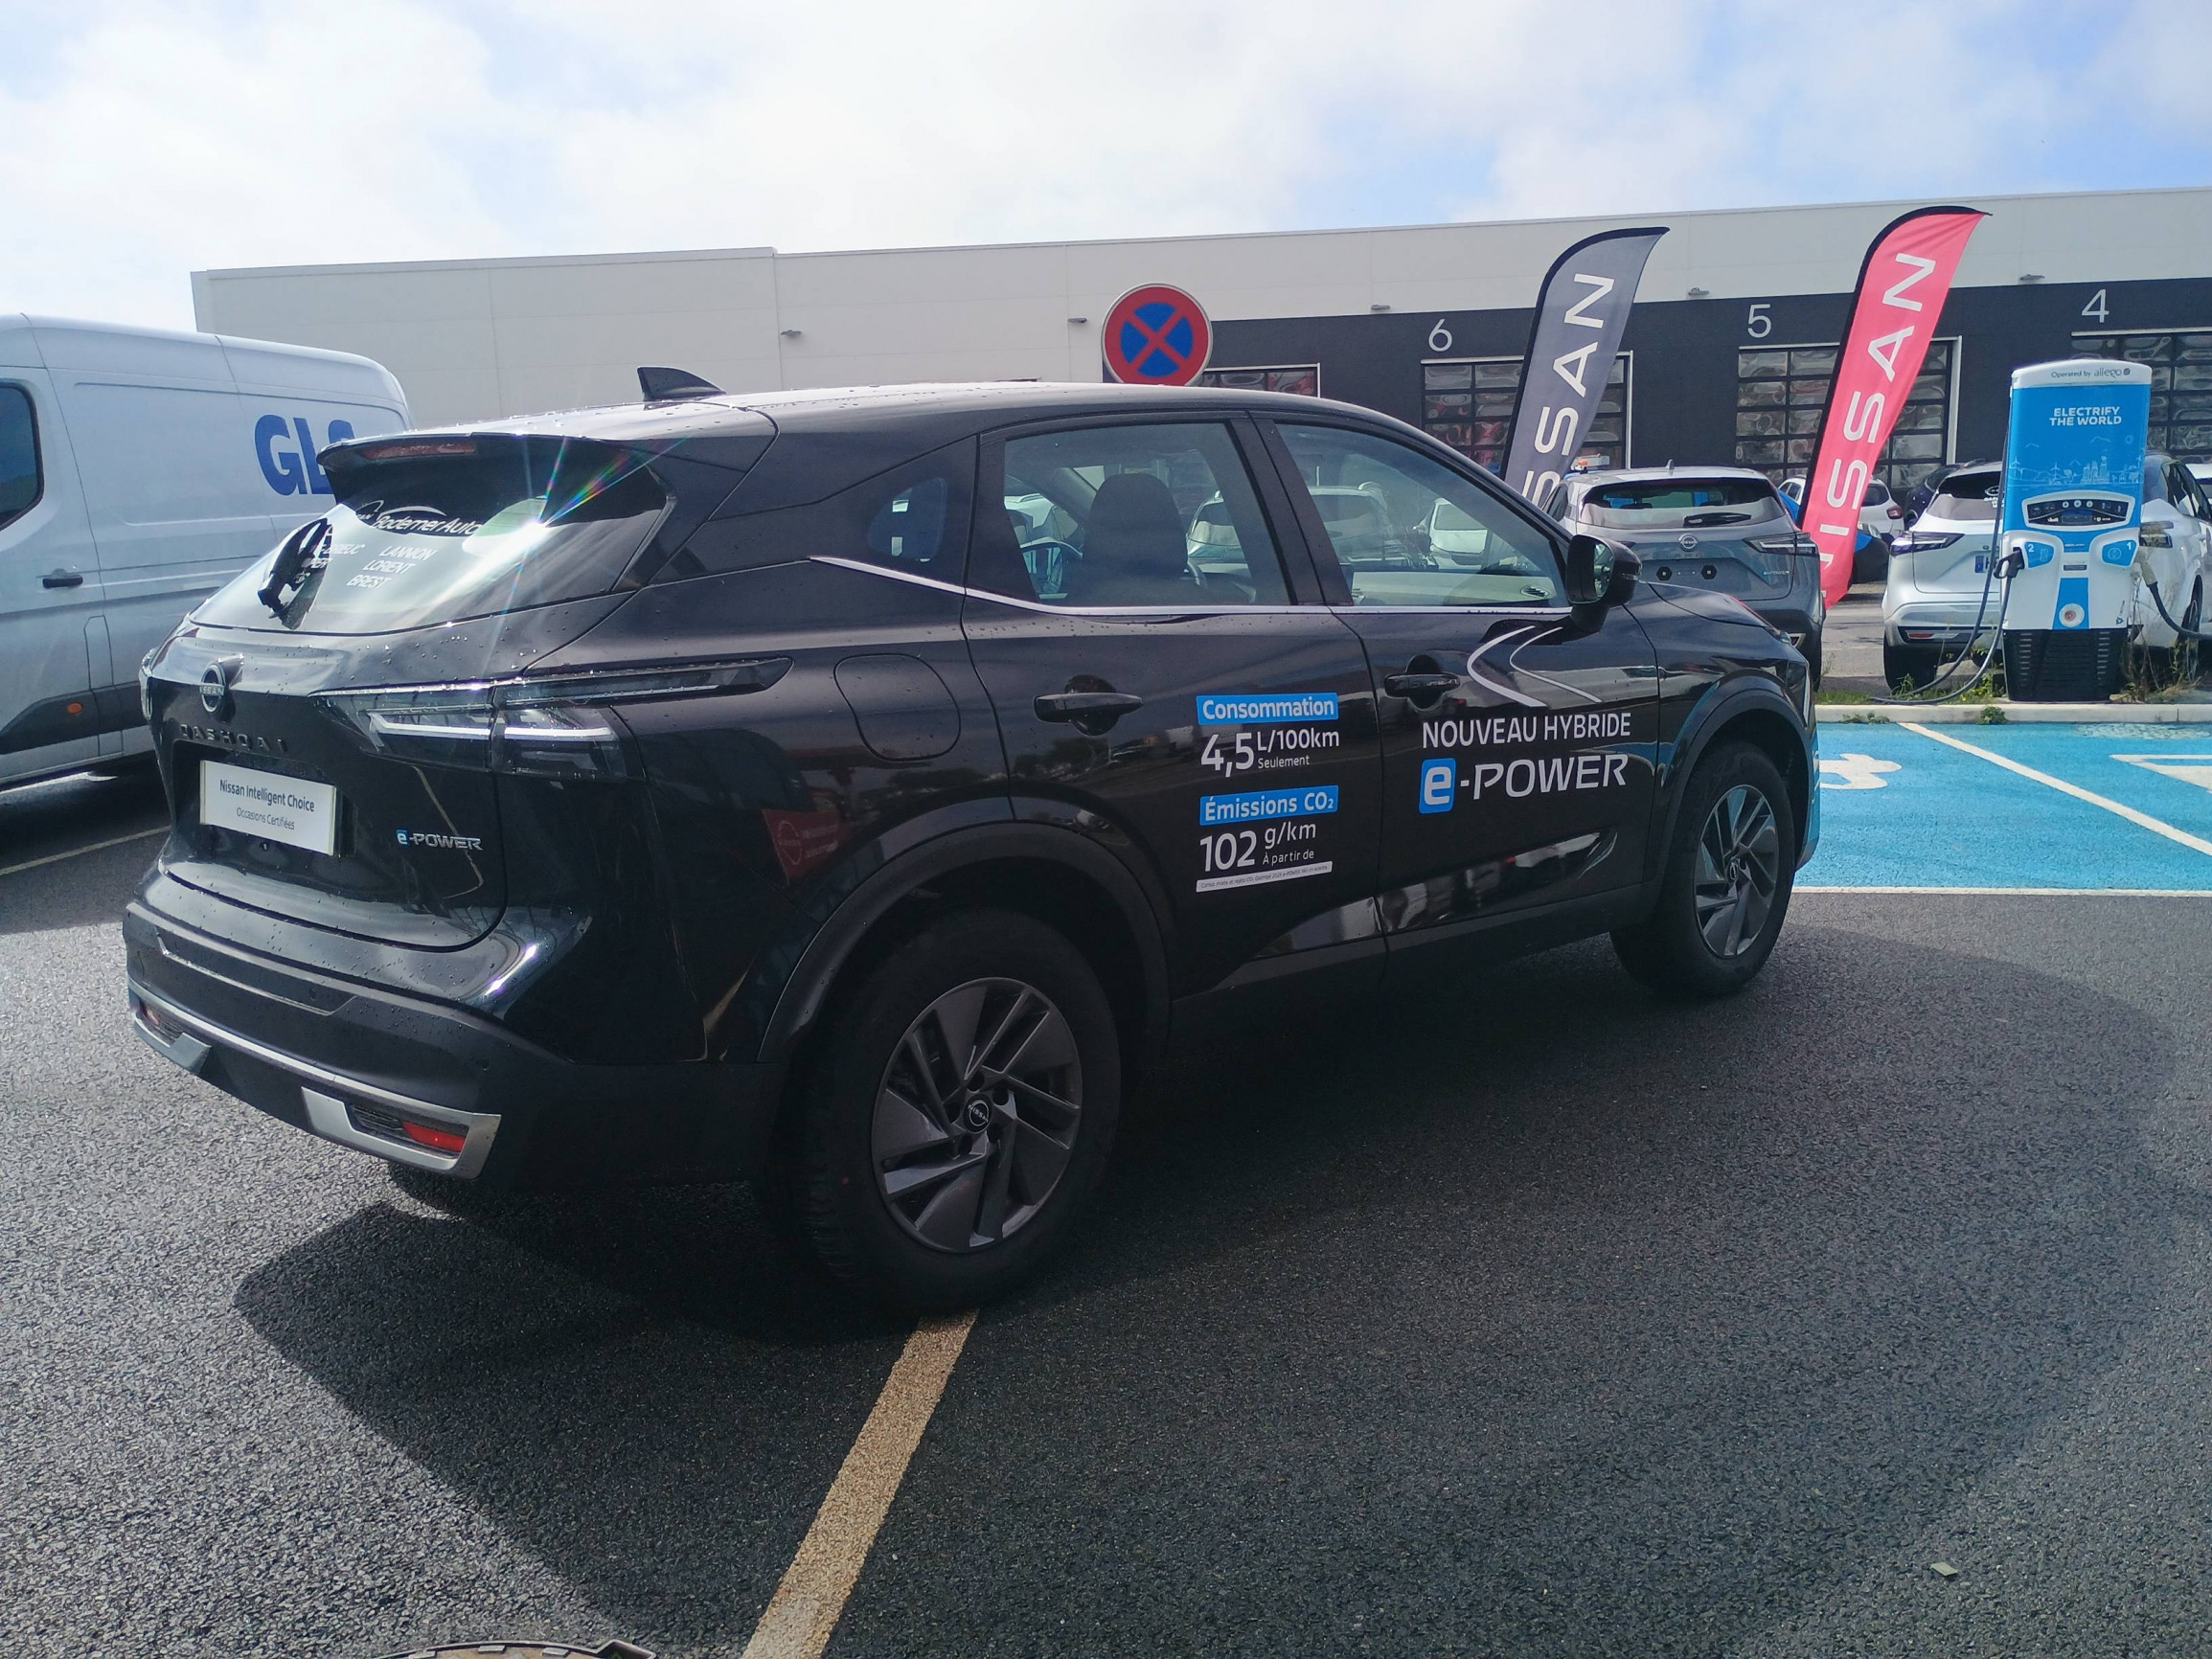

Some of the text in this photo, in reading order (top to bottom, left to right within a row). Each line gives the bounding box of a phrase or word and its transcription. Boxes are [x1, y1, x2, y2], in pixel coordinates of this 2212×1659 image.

[2081, 288, 2109, 324] 4
[1747, 304, 1772, 339] 5
[1427, 318, 1453, 352] 6
[2094, 368, 2122, 377] allego
[2049, 416, 2122, 426] THE WORLD
[2053, 406, 2120, 417] ELECTRIFY
[2027, 543, 2035, 553] 2
[2126, 541, 2132, 551] 1
[362, 559, 416, 574] LORIENT
[346, 575, 392, 589] BREST
[1202, 695, 1334, 719] Consommation
[1422, 712, 1631, 749] NOUVEAU HYBRIDE
[1200, 727, 1340, 777] 4,5 L/100km
[1257, 754, 1311, 769] Seulement
[1423, 753, 1629, 806] e-POWER
[219, 779, 315, 812] Nissan Intelligent Choice
[236, 807, 266, 824] Occasions
[1204, 795, 1298, 822] Émissions
[396, 830, 484, 851] e-POWER
[1199, 820, 1316, 873] 102 g/km
[1262, 849, 1314, 866] À partir de
